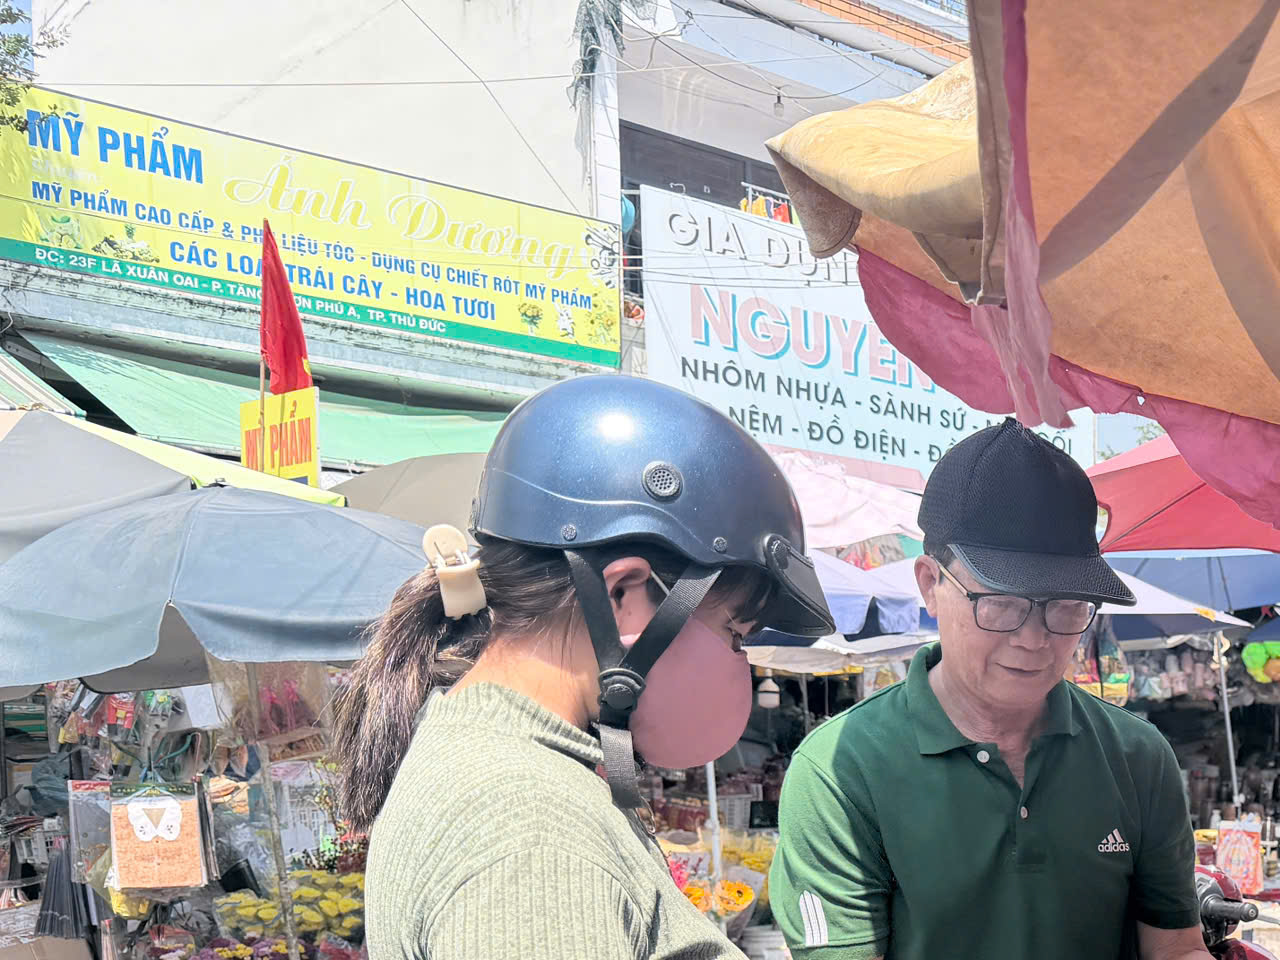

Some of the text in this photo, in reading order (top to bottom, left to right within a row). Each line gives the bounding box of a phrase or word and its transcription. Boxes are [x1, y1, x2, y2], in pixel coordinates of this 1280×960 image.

[27, 108, 204, 184] MỸ PHẨM
[31, 180, 69, 203] MỸ
[70, 189, 128, 217] PHẨM
[134, 202, 172, 226] CAO
[178, 209, 215, 234] CẤP
[221, 221, 235, 240] &
[281, 233, 319, 256] LIỆU
[323, 241, 355, 263] TÓC
[371, 252, 416, 276] DỤNG
[421, 262, 441, 283] CỤ
[446, 266, 489, 289] CHIẾT
[493, 275, 521, 297] RÓT
[525, 282, 546, 301] MỸ
[551, 287, 592, 310] PHẨM
[387, 193, 580, 281] Dương
[667, 211, 859, 288] GIA DỤN
[34, 247, 65, 265] ĐC:
[68, 254, 97, 269] 23F
[125, 263, 169, 283] XUÂN
[174, 275, 199, 290] OAI
[211, 281, 224, 294] P.
[315, 300, 345, 315] PHÚ
[347, 306, 361, 320] A,
[367, 308, 388, 322] TP.
[388, 312, 416, 328] THỦ
[418, 317, 447, 333] ĐỨC
[169, 241, 218, 269] CÁC
[284, 263, 335, 292] TRÁI
[342, 273, 383, 300] CÂY
[405, 286, 447, 312] HOA
[452, 295, 496, 321] TƯƠI
[680, 355, 766, 393] NHÔM
[776, 374, 848, 411] NHỰA
[869, 391, 932, 425] SÀNH
[939, 407, 967, 432] SỨ
[269, 399, 313, 469] PHẨM
[807, 411, 845, 446] ĐỒ
[853, 428, 906, 461] ĐIỆN
[1097, 842, 1130, 853] adidas
